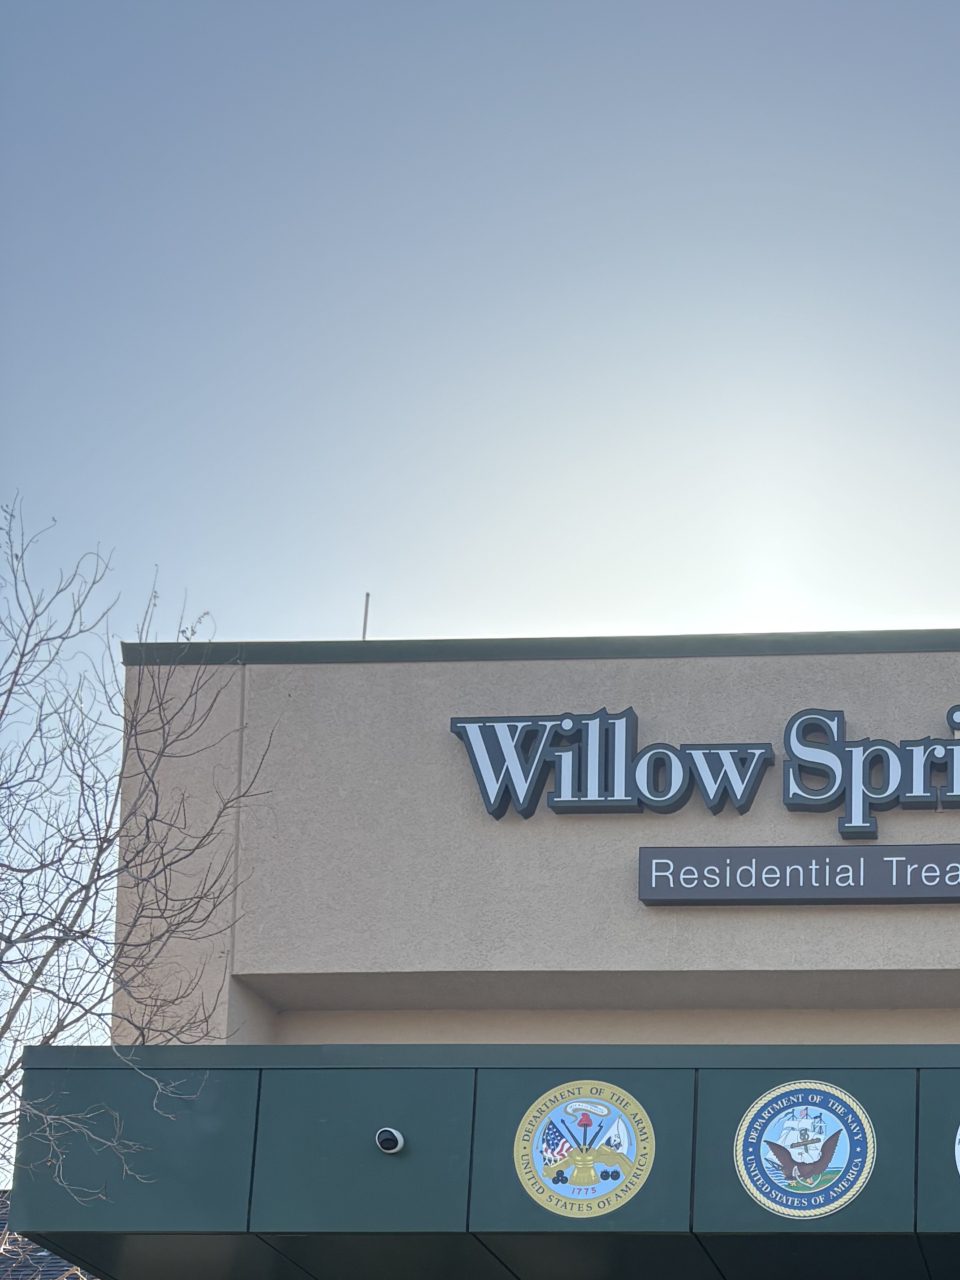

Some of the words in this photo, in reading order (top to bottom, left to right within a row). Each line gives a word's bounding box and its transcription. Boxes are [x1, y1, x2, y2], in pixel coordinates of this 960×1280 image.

[451, 709, 771, 812] Willow
[651, 857, 865, 889] Residential
[522, 1087, 584, 1143] DEPARTMENT
[589, 1086, 606, 1096] OF
[610, 1092, 632, 1111] THE
[630, 1111, 650, 1147] ARMY
[748, 1093, 805, 1143] DEPARTMENT
[808, 1094, 824, 1104] OF
[827, 1098, 848, 1117] THE
[845, 1112, 863, 1142] NAVY
[520, 1153, 546, 1196] UNITED
[546, 1195, 593, 1212] STATES
[597, 1197, 613, 1210] OF
[615, 1152, 649, 1201] AMERICA
[571, 1187, 597, 1195] 1775
[746, 1155, 771, 1194] UNITED
[769, 1189, 808, 1207] STATES
[811, 1194, 826, 1206] OF
[829, 1156, 863, 1200] AMERICA
